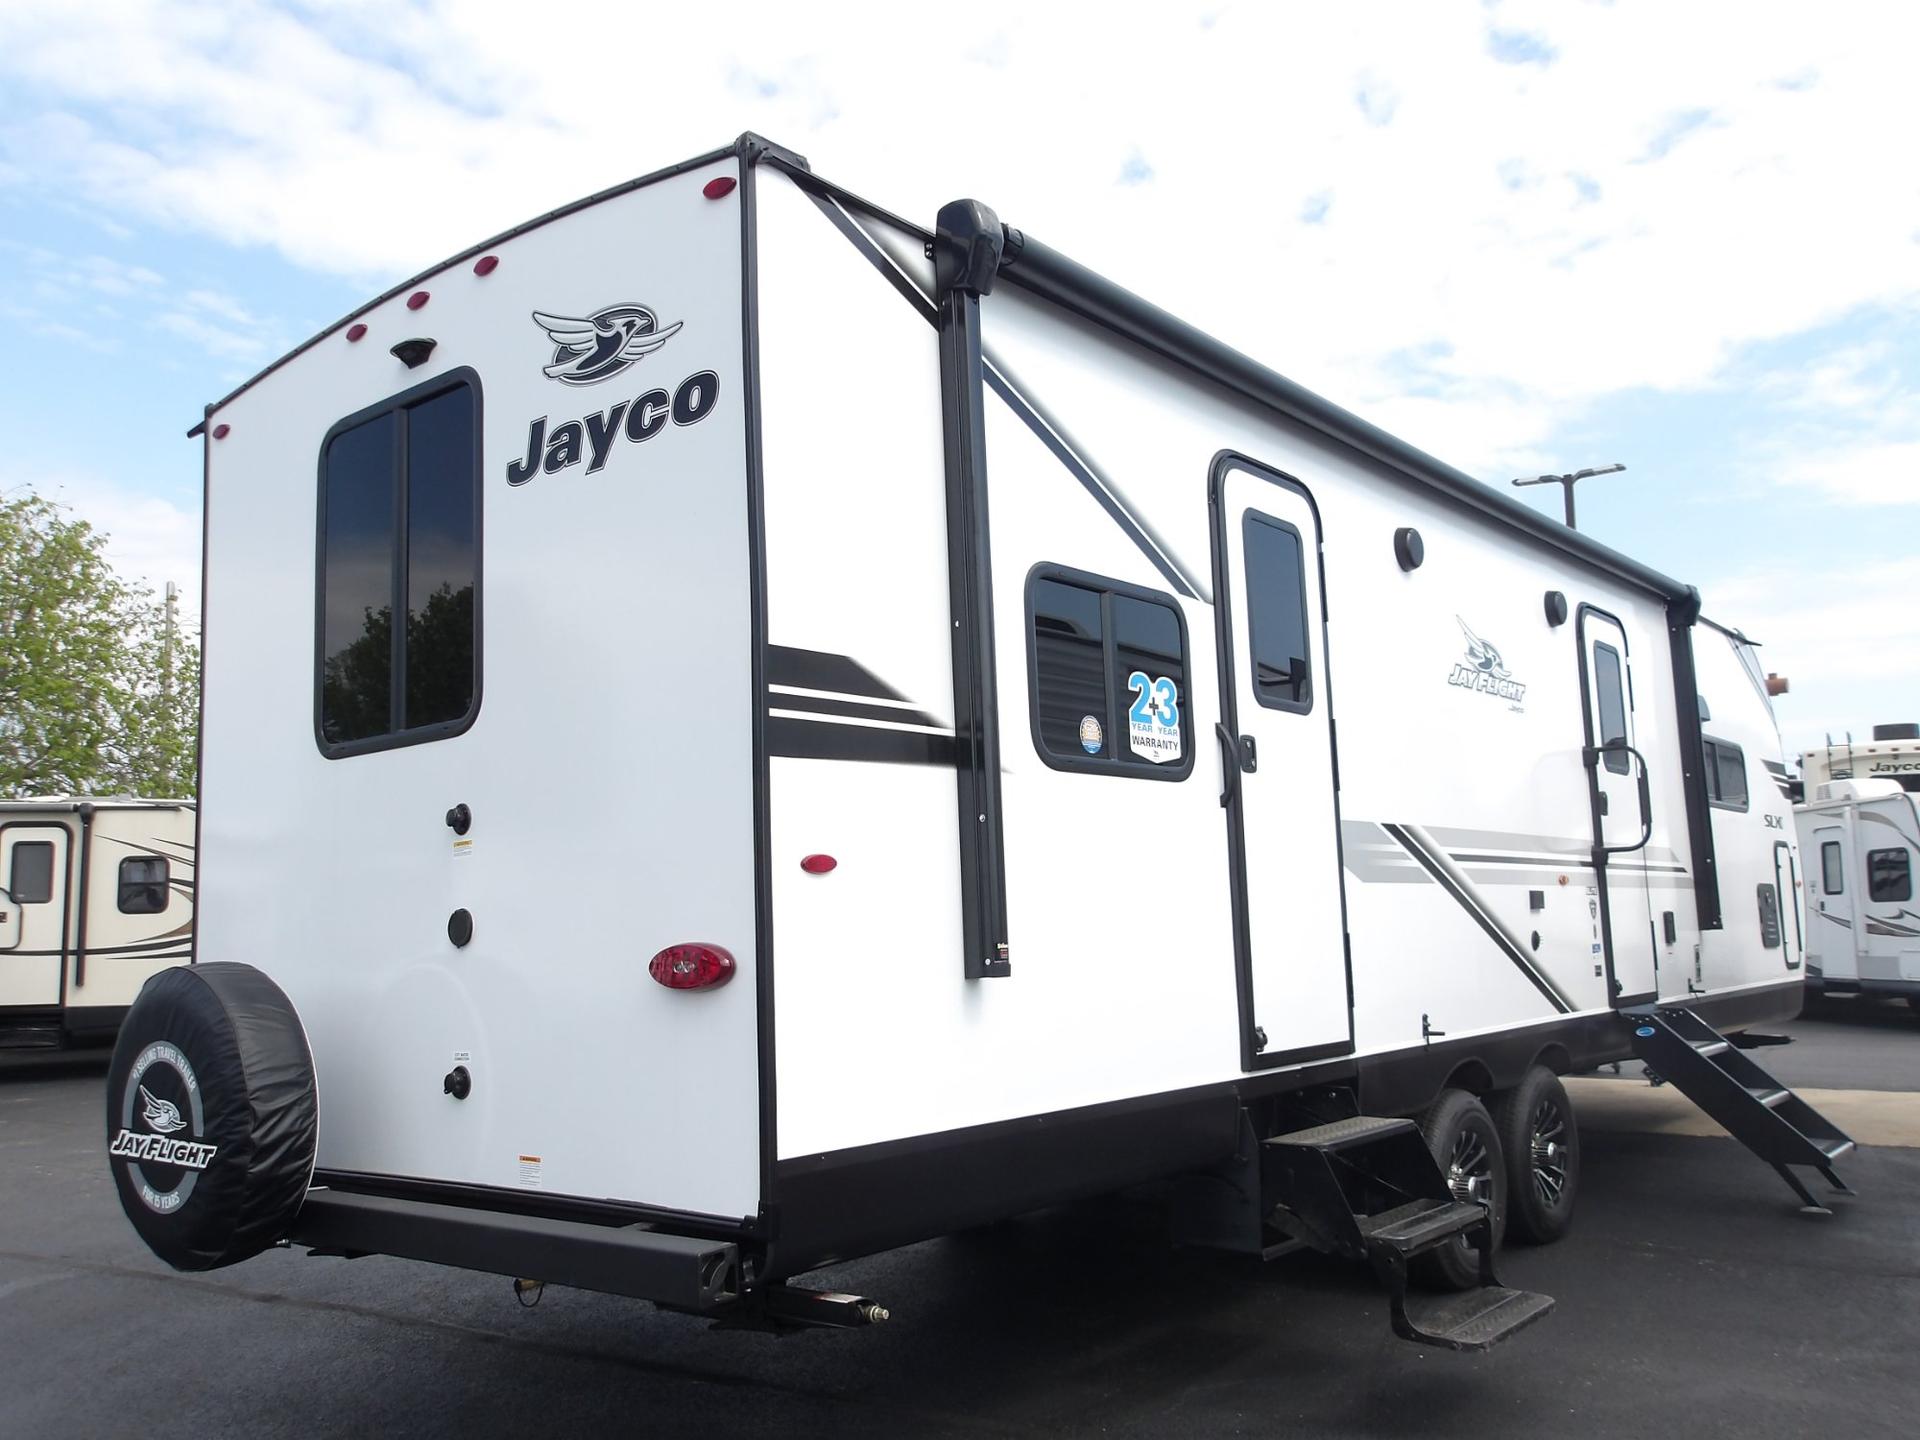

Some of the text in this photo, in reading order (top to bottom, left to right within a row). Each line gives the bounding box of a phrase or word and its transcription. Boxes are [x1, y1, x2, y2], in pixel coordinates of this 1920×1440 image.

[506, 369, 720, 487] Jayco
[1131, 722, 1178, 737] YEAR YEAR
[1131, 735, 1179, 751] WARRANTY
[156, 1046, 177, 1064] TRAVEL
[177, 1054, 197, 1092] TRAILER
